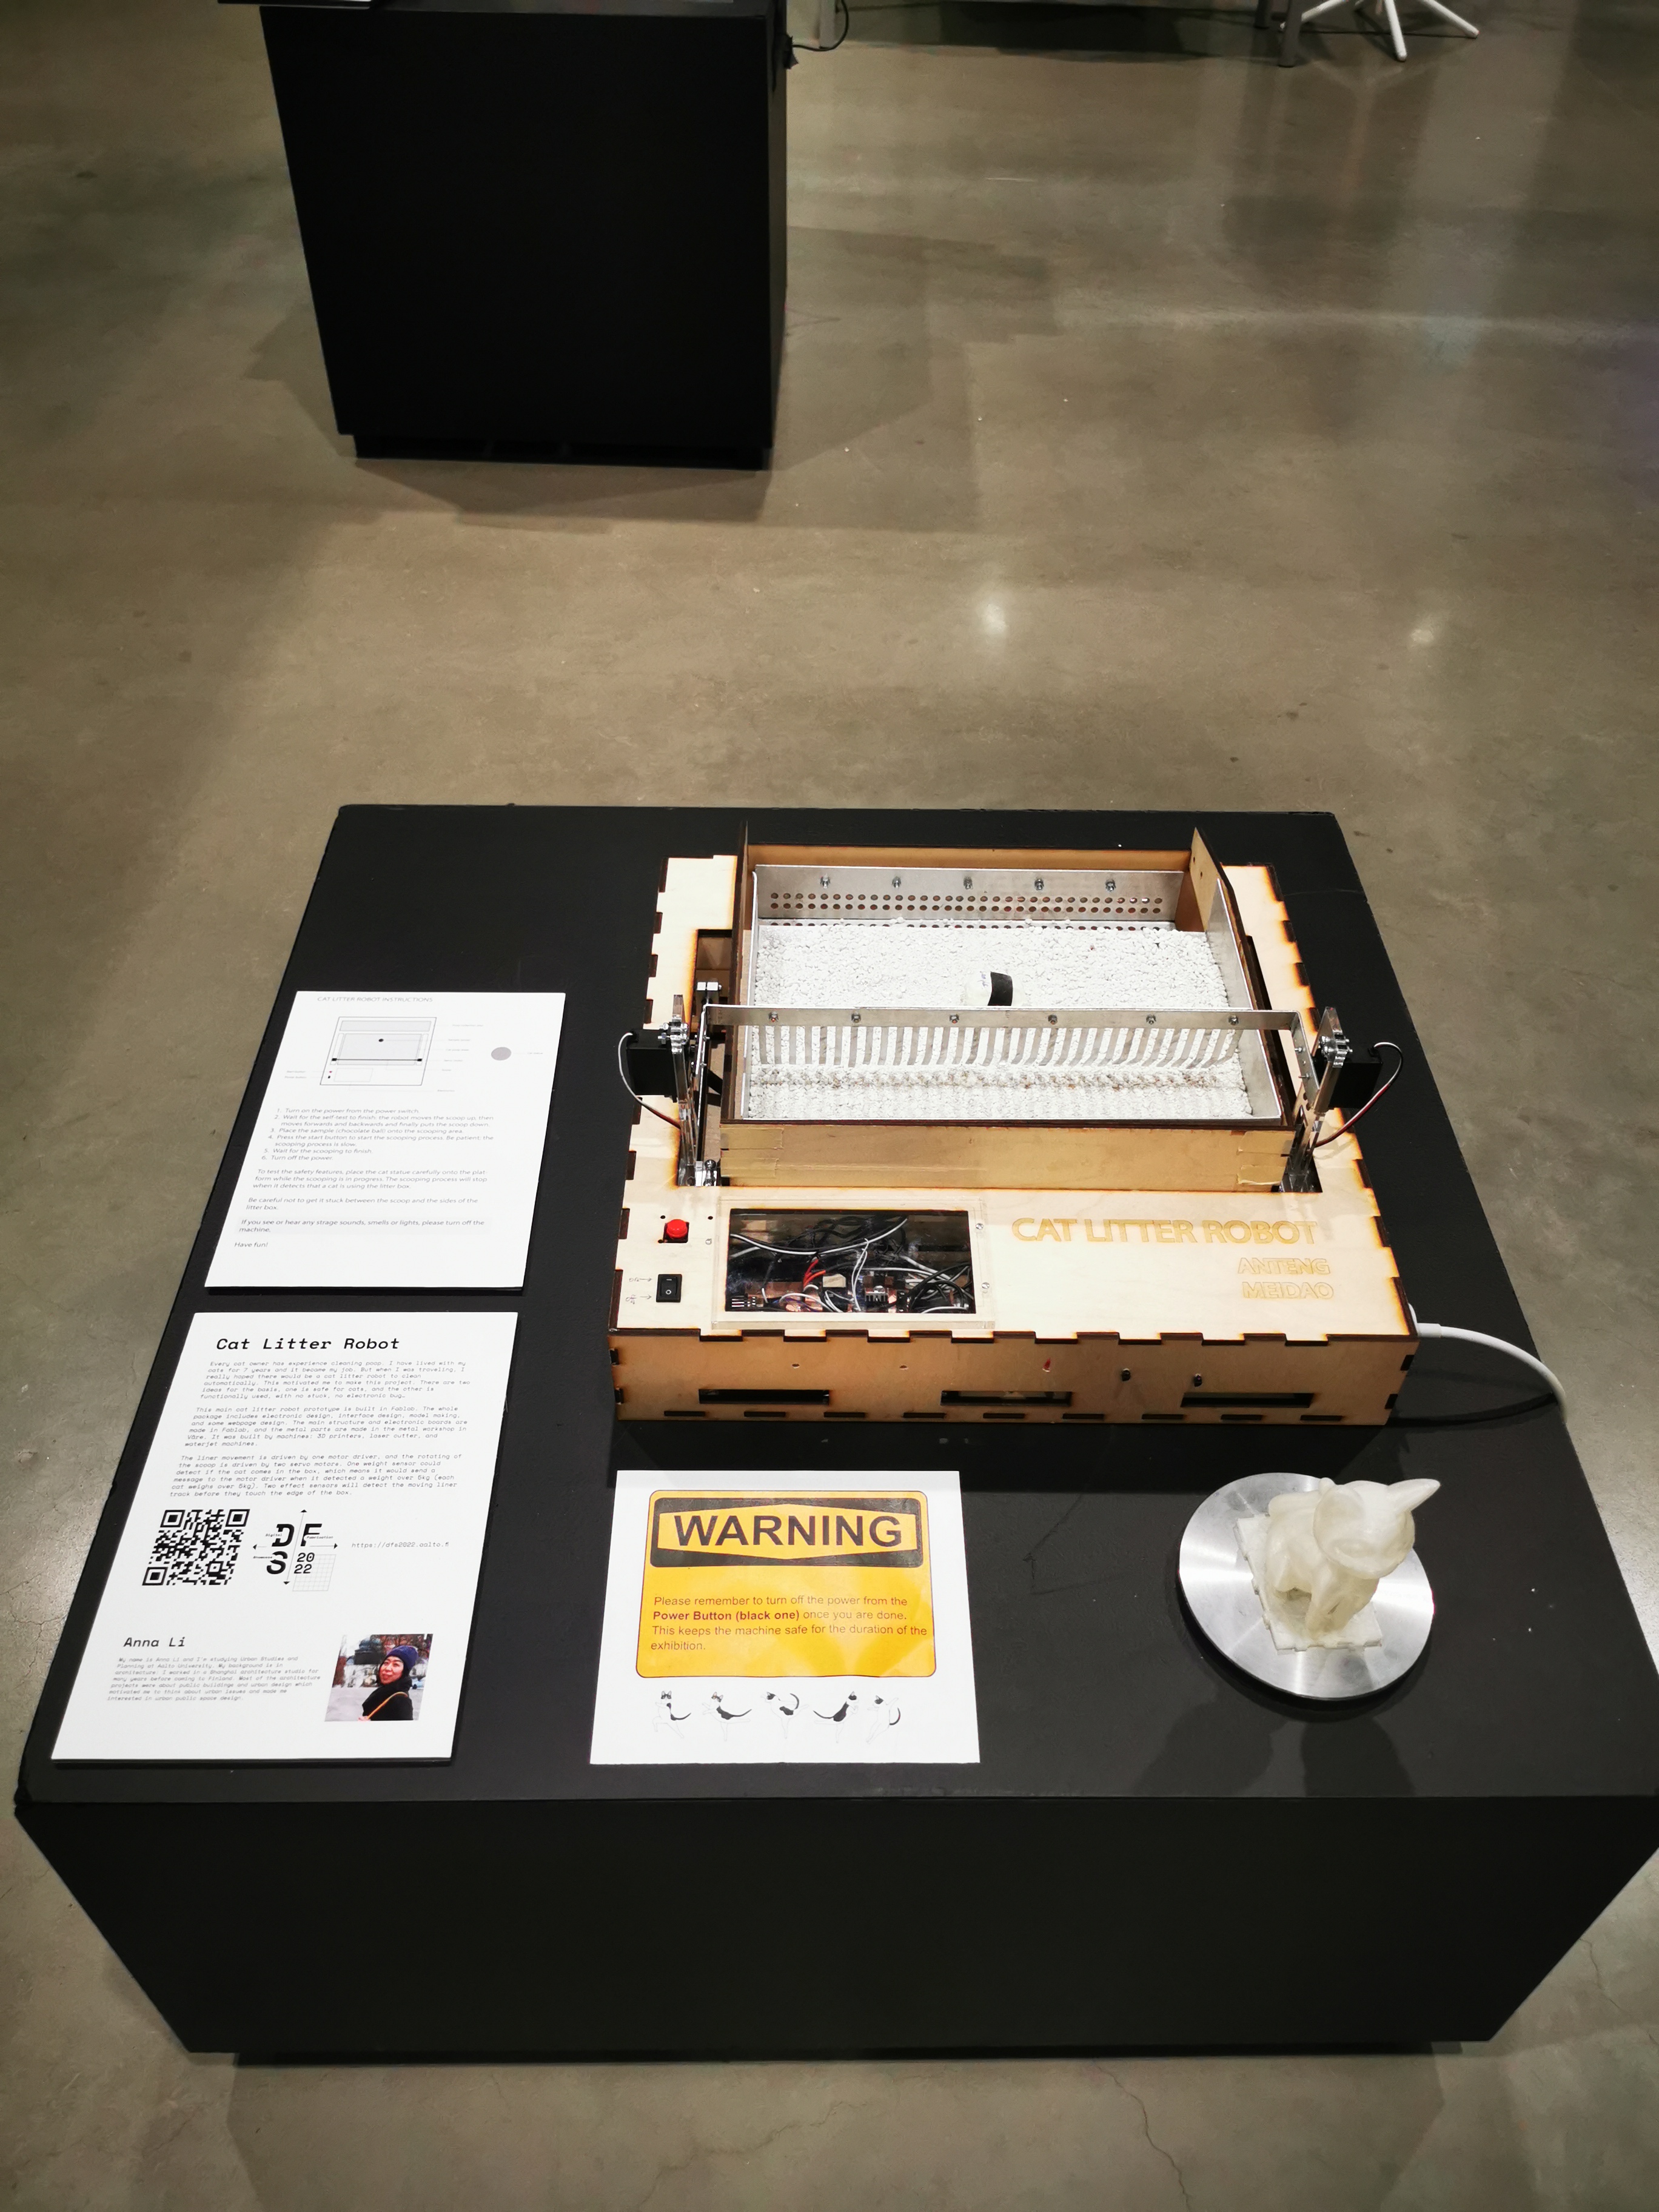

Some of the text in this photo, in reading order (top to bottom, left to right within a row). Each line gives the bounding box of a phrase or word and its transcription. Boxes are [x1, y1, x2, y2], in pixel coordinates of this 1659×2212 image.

[1012, 1218, 1318, 1244] CAT LITTER ROBOT
[1238, 1257, 1330, 1275] ANTENG
[1242, 1282, 1334, 1299] MEIDAO
[217, 1338, 398, 1349] Cat Litter Robot
[272, 1523, 322, 1547] D F
[674, 1515, 902, 1547] WARNING
[266, 1550, 288, 1575] S
[297, 1552, 315, 1563] 20
[294, 1564, 312, 1574] 22
[654, 1597, 691, 1605] Please
[891, 1597, 907, 1606] the
[694, 1611, 731, 1620] Button
[736, 1611, 770, 1621] (black
[774, 1610, 799, 1621] one)
[652, 1624, 927, 1637] This keeps the machine safe for the duration of the
[124, 1637, 185, 1647] Anna Li
[651, 1641, 705, 1651] exhibition.
